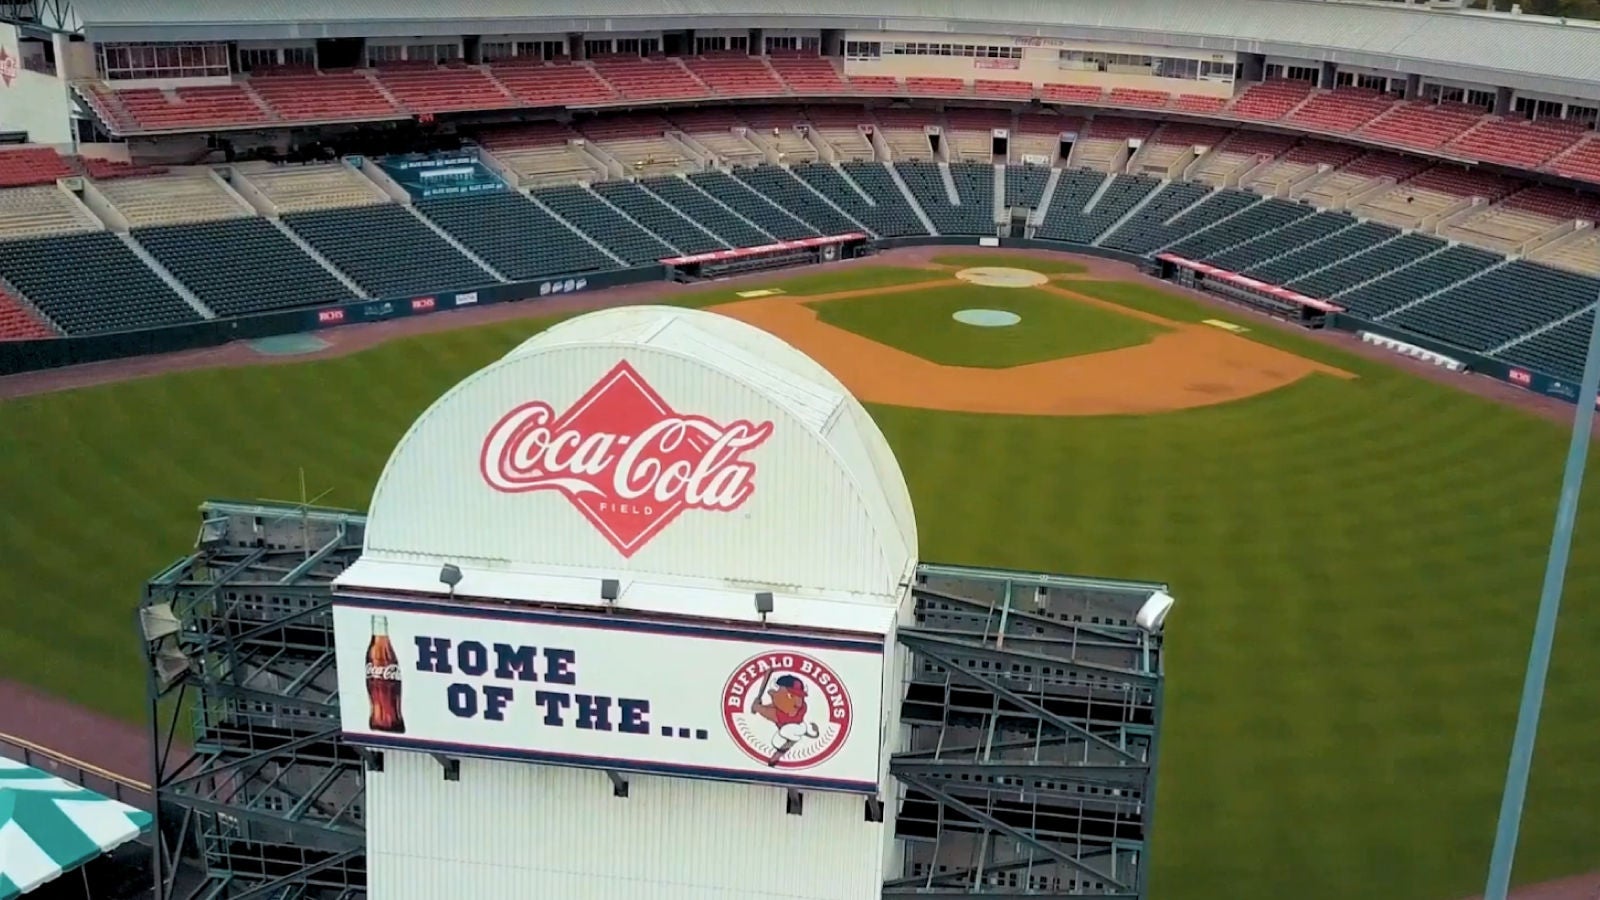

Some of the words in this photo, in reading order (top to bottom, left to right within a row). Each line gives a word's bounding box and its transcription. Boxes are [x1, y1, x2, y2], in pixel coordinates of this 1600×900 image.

[484, 405, 773, 507] Coca-Cola
[599, 502, 653, 515] FIELD
[414, 636, 575, 685] HOME
[727, 656, 793, 708] BUFFALO
[800, 660, 845, 718] BISONS
[447, 683, 513, 721] OF
[536, 690, 708, 739] THE...
